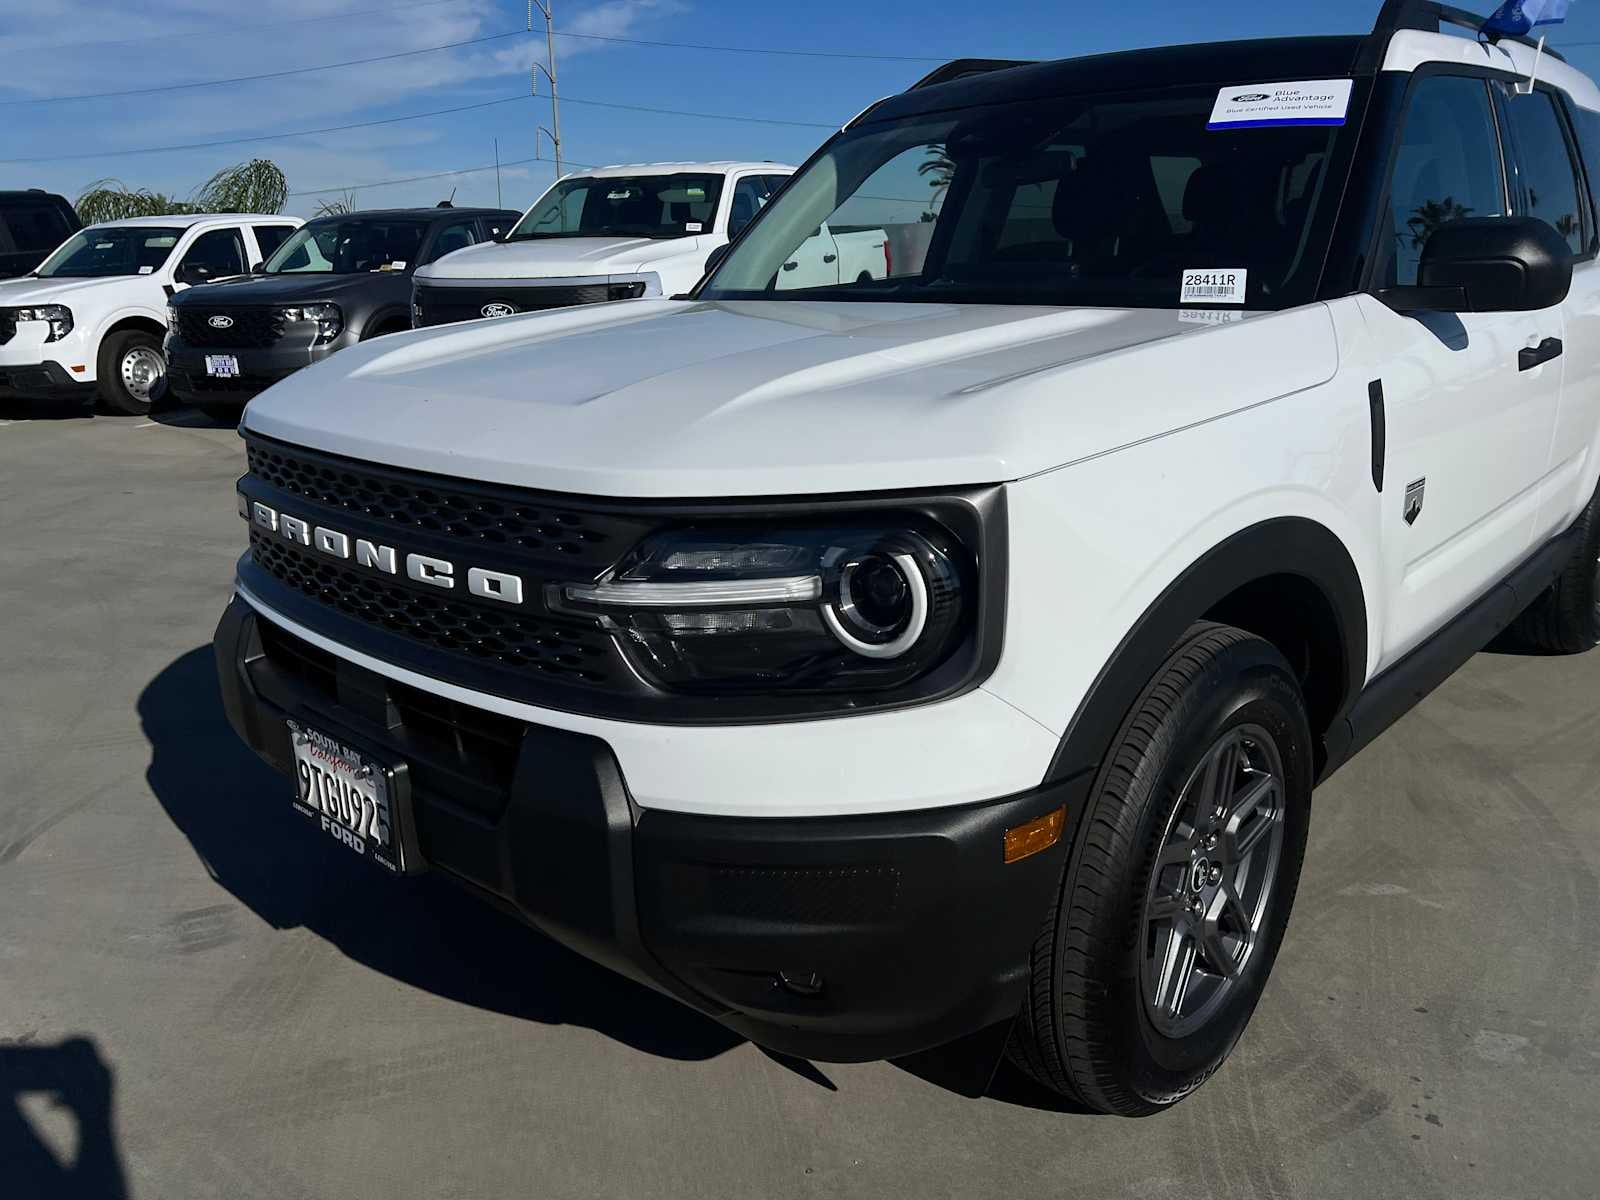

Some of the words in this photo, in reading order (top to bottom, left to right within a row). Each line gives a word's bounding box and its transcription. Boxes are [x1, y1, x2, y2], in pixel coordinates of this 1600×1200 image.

[1185, 275, 1235, 285] 28411R
[253, 501, 524, 605] BRONCO
[306, 727, 340, 753] SOUTH
[343, 746, 361, 763] BAY
[321, 815, 365, 855] FORD
